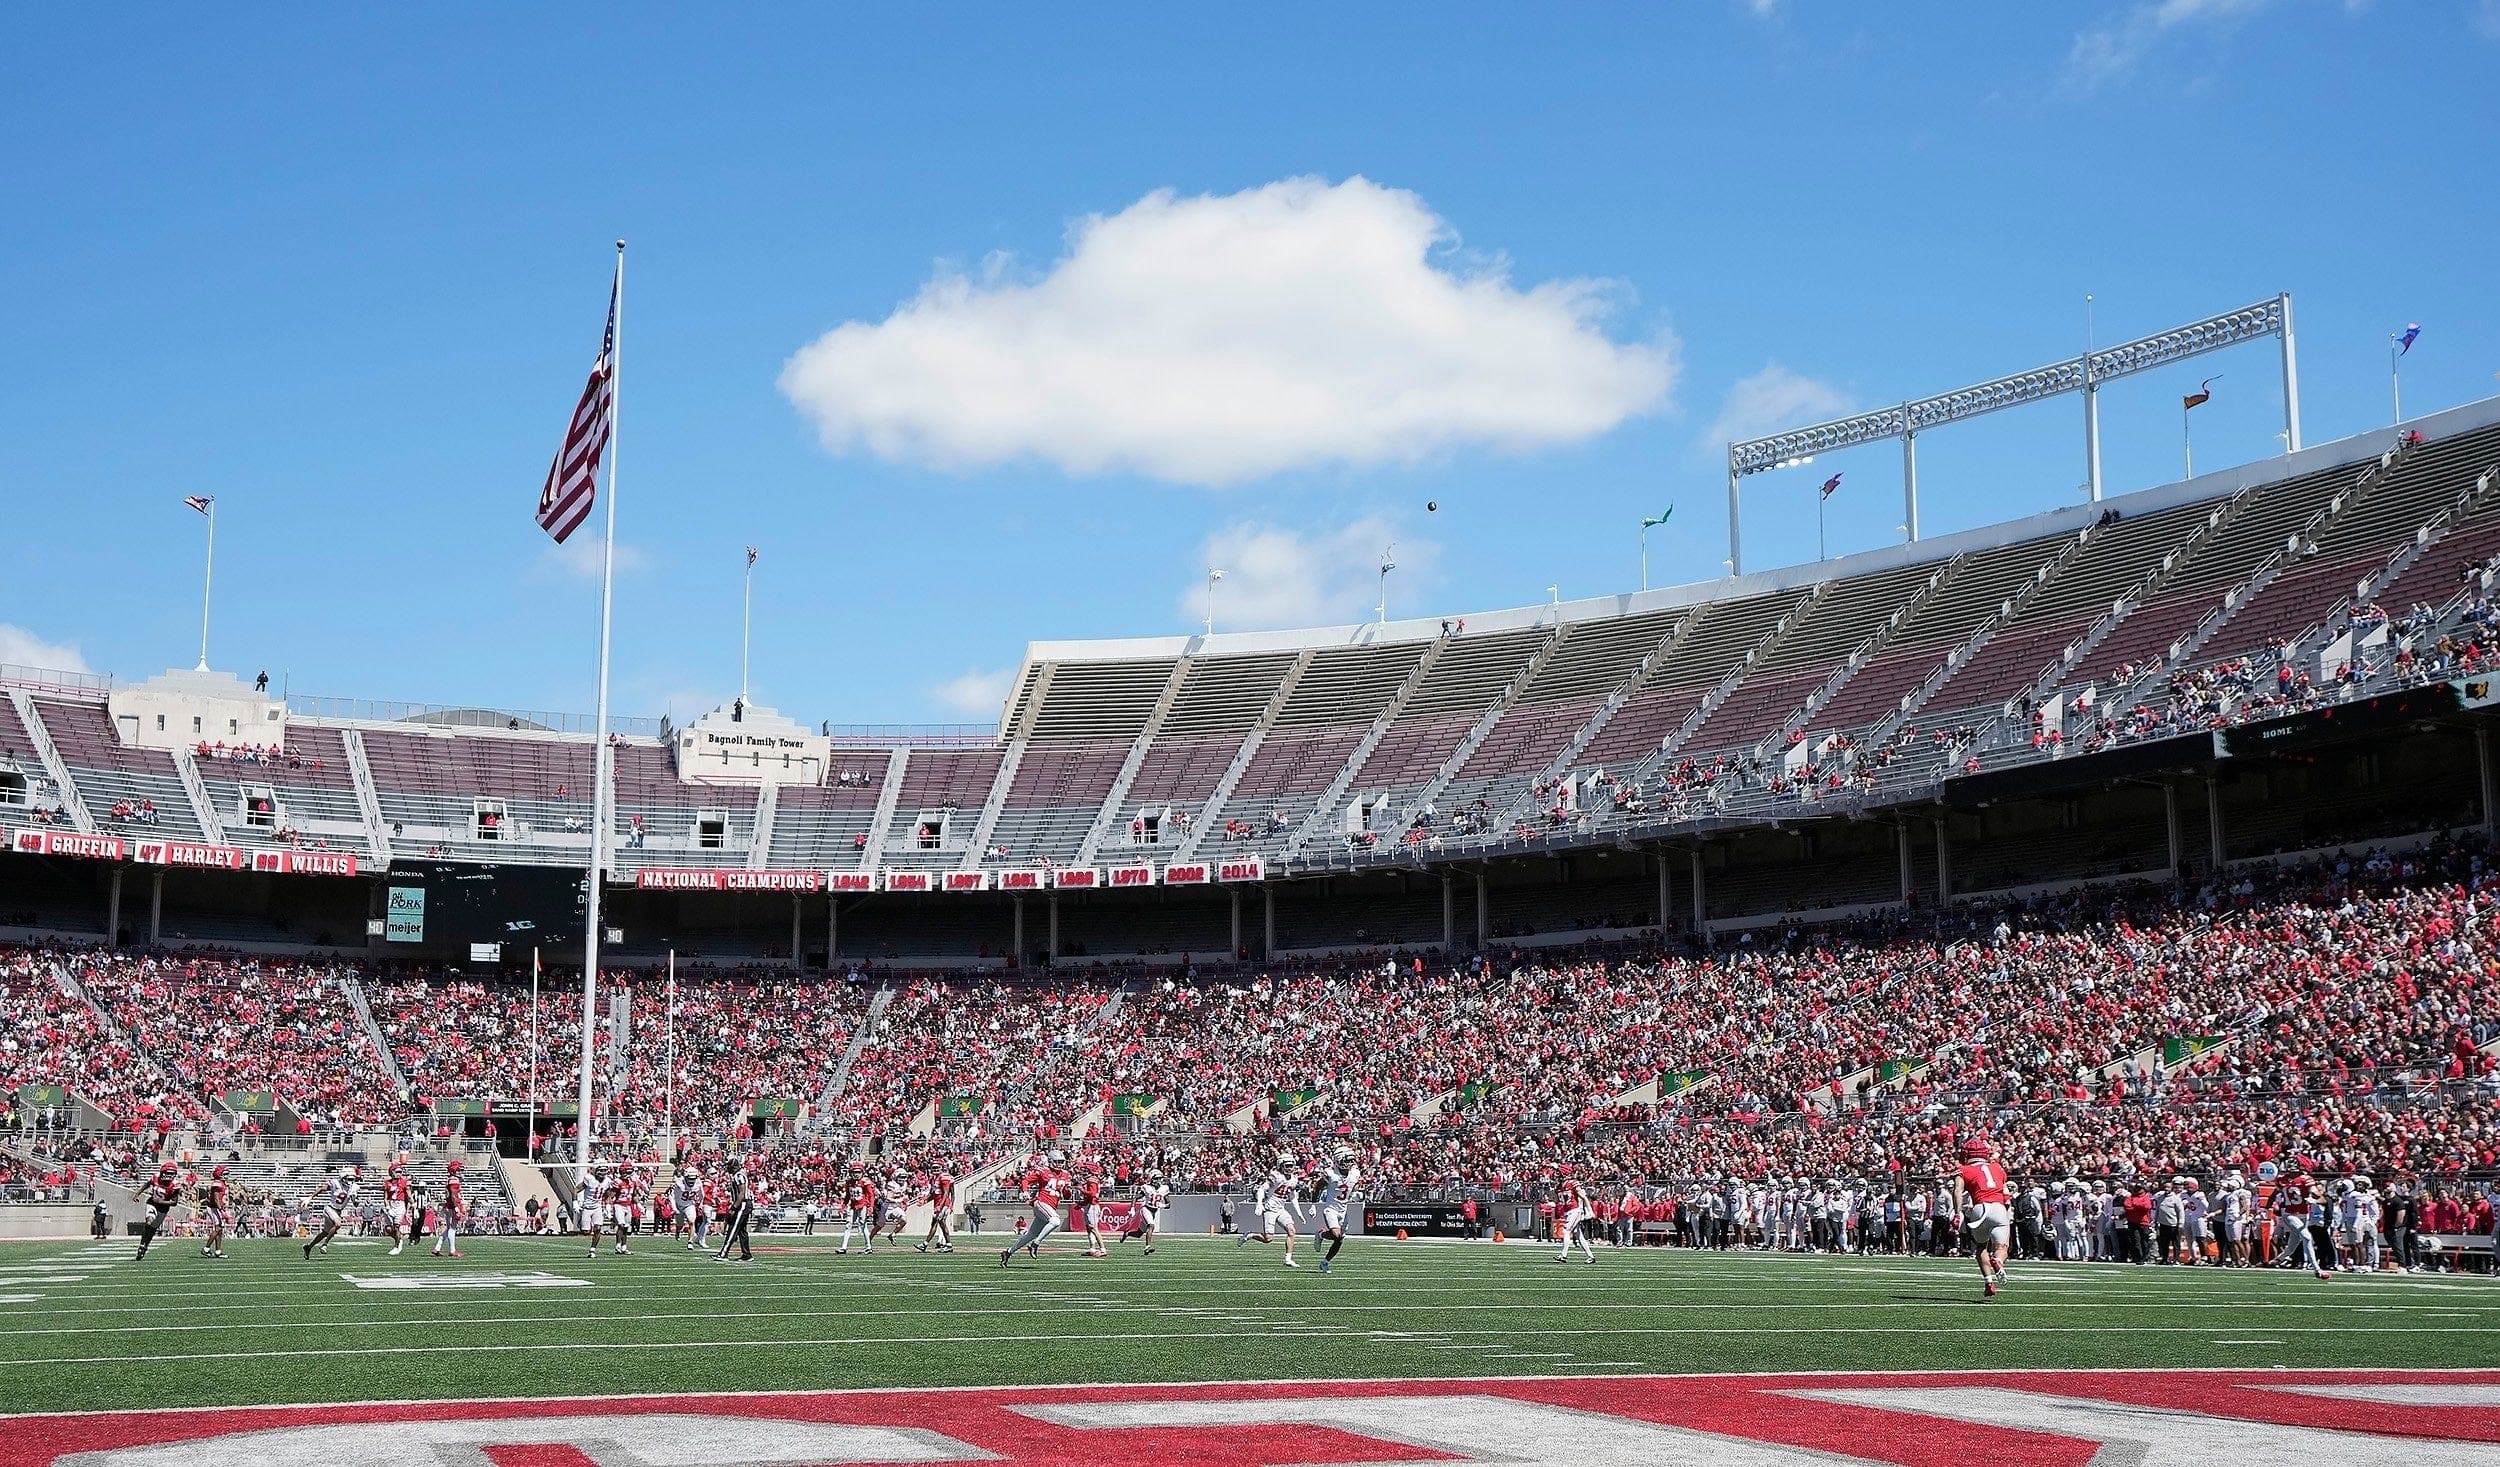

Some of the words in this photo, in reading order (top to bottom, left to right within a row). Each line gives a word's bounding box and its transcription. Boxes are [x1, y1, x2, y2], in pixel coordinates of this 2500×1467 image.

[2262, 726, 2293, 739] HOME
[708, 733, 743, 745] Bagnoli
[746, 736, 776, 749] Family
[779, 738, 804, 748] Tower
[51, 836, 119, 857] GRIFFIN
[139, 844, 162, 860] 47
[172, 846, 235, 866] HARLEY
[291, 852, 349, 874] WILLIS
[643, 871, 718, 888] NATIONAL
[727, 872, 815, 889] CHAMPIONS
[1112, 869, 1149, 885] 1970
[1167, 866, 1205, 882] 2002
[1222, 864, 1259, 880] 2014
[390, 898, 422, 909] PORK
[368, 921, 383, 934] 40
[388, 922, 421, 934] meijer
[607, 929, 622, 943] 40
[1980, 1164, 1997, 1189] 1
[2282, 1186, 2303, 1206] 13
